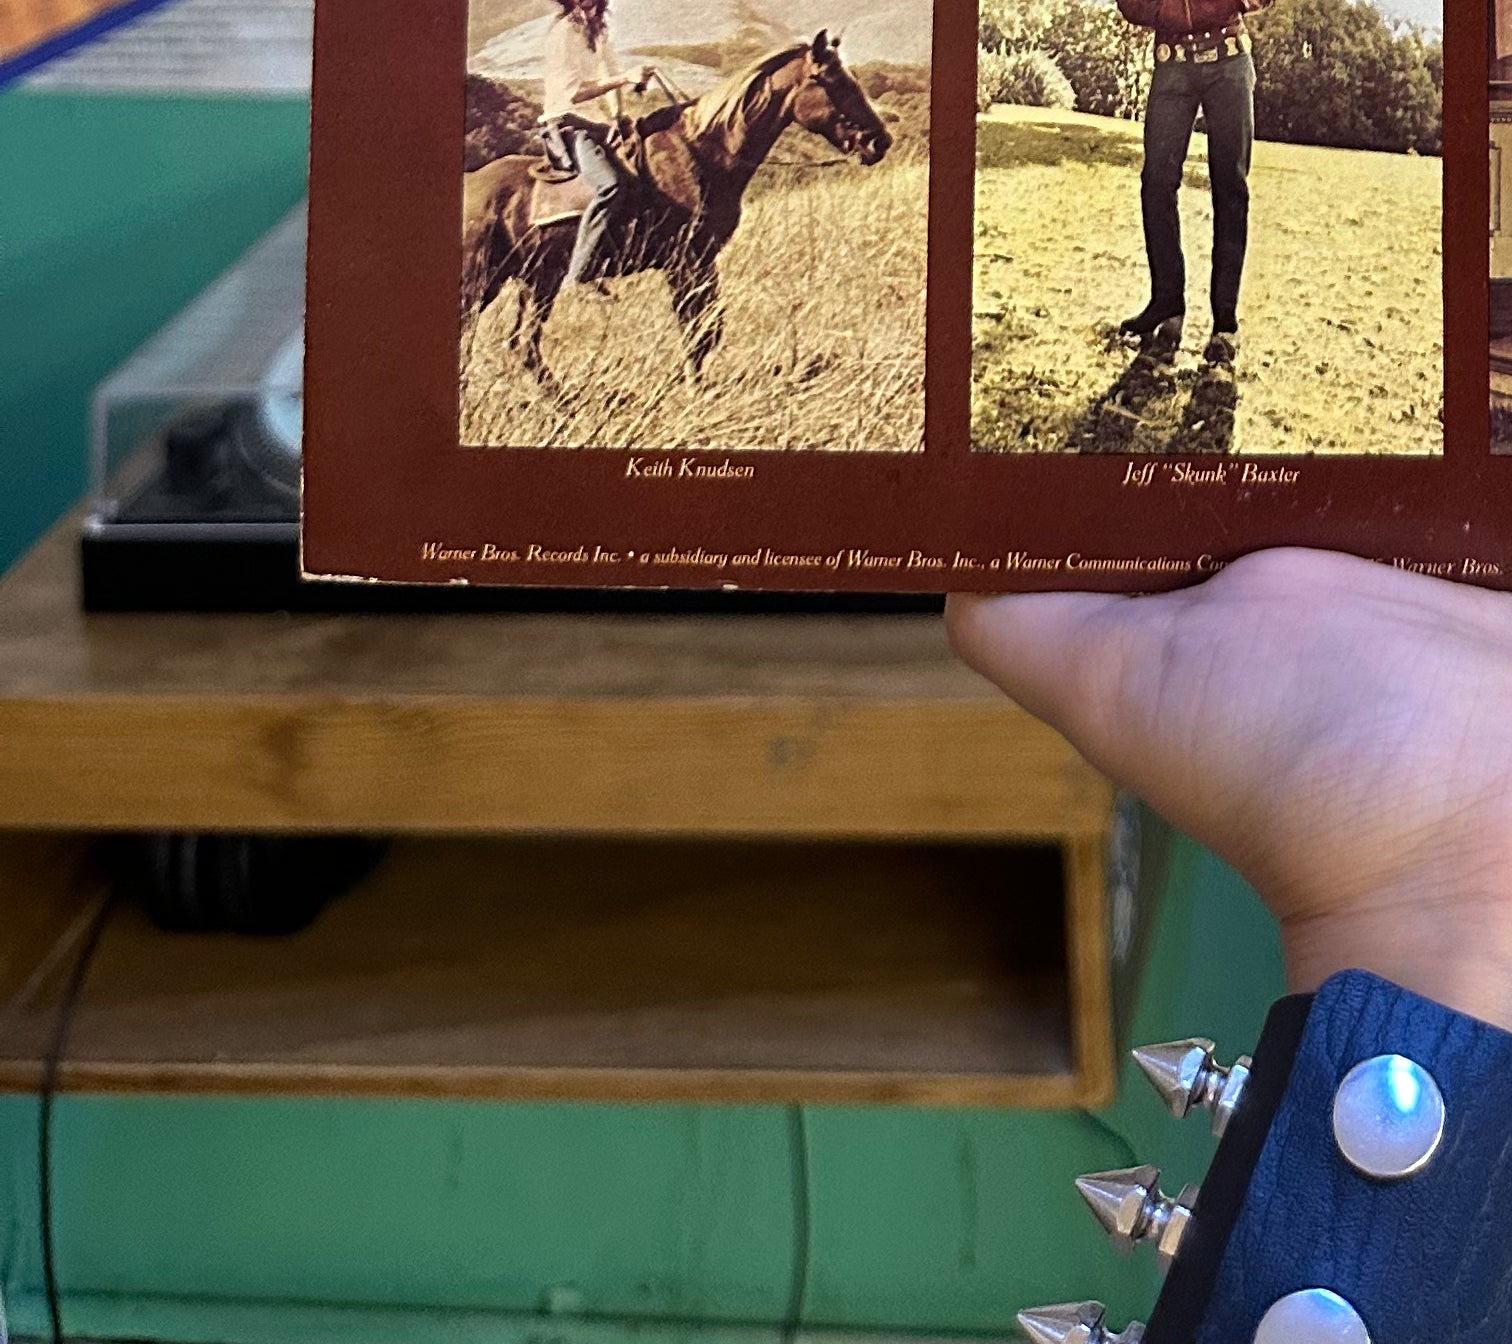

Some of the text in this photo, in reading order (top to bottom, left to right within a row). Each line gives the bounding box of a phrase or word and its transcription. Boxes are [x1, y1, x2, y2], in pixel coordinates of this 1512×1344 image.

[626, 458, 754, 477] Keith Knudsen
[1123, 462, 1158, 486] Jeff
[1242, 463, 1300, 482] Baxter
[422, 543, 476, 560] Warner
[526, 544, 588, 562] Records
[593, 546, 620, 562] Inc.
[640, 553, 649, 563] a
[654, 547, 728, 568] subsidiary
[732, 549, 761, 565] and
[764, 548, 821, 566] licensee
[826, 550, 844, 569] of
[848, 550, 902, 567] Warner
[907, 550, 947, 568] Bros.
[990, 559, 1000, 568] a
[1007, 552, 1061, 569] Warner
[1066, 553, 1190, 570] Communications
